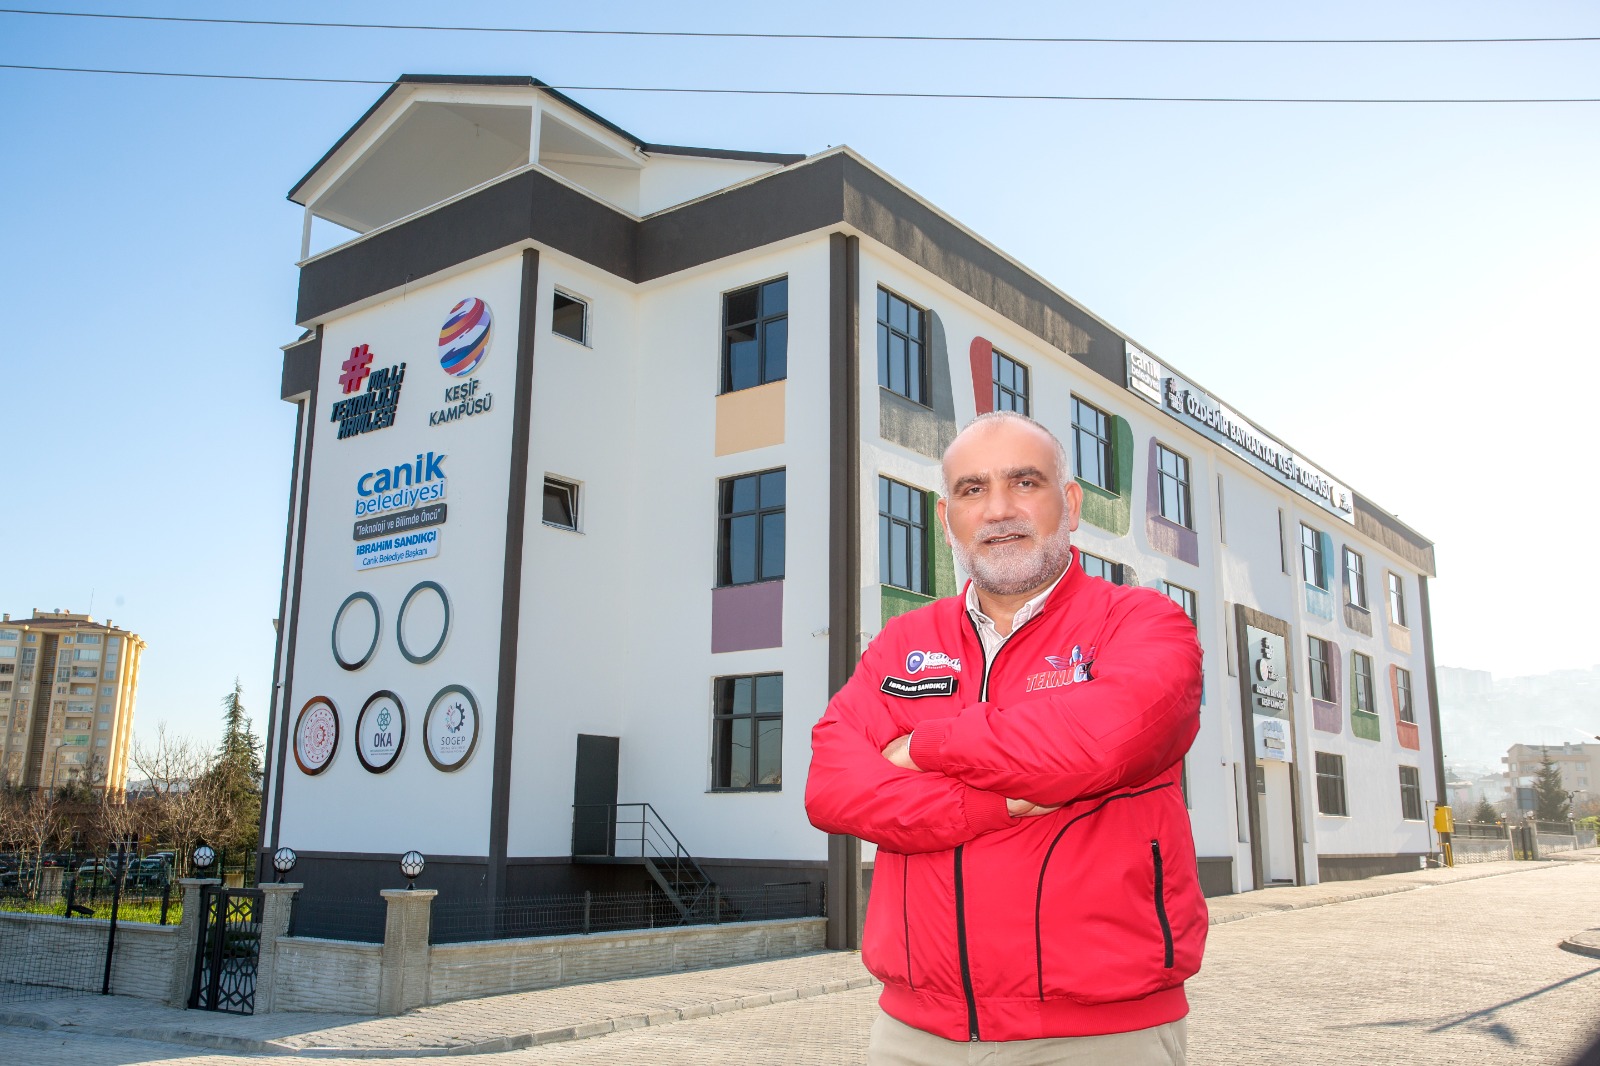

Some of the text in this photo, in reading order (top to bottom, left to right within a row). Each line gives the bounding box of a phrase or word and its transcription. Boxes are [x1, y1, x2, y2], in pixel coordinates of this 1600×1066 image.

[445, 377, 479, 403] KEŞİF
[429, 392, 492, 426] KAMPÜSÜ
[1187, 391, 1229, 436] ÖZDEMİR
[1230, 421, 1277, 467] BAYRAKTAR
[357, 451, 446, 497] canik
[355, 480, 444, 516] belediyesi
[386, 520, 394, 530] ve
[395, 513, 420, 527] Bilimde
[394, 531, 437, 549] SANDIKÇI
[362, 555, 379, 566] Canik
[379, 551, 405, 564] Belediye
[374, 732, 393, 748] OKA
[440, 736, 466, 746] SOGEP
